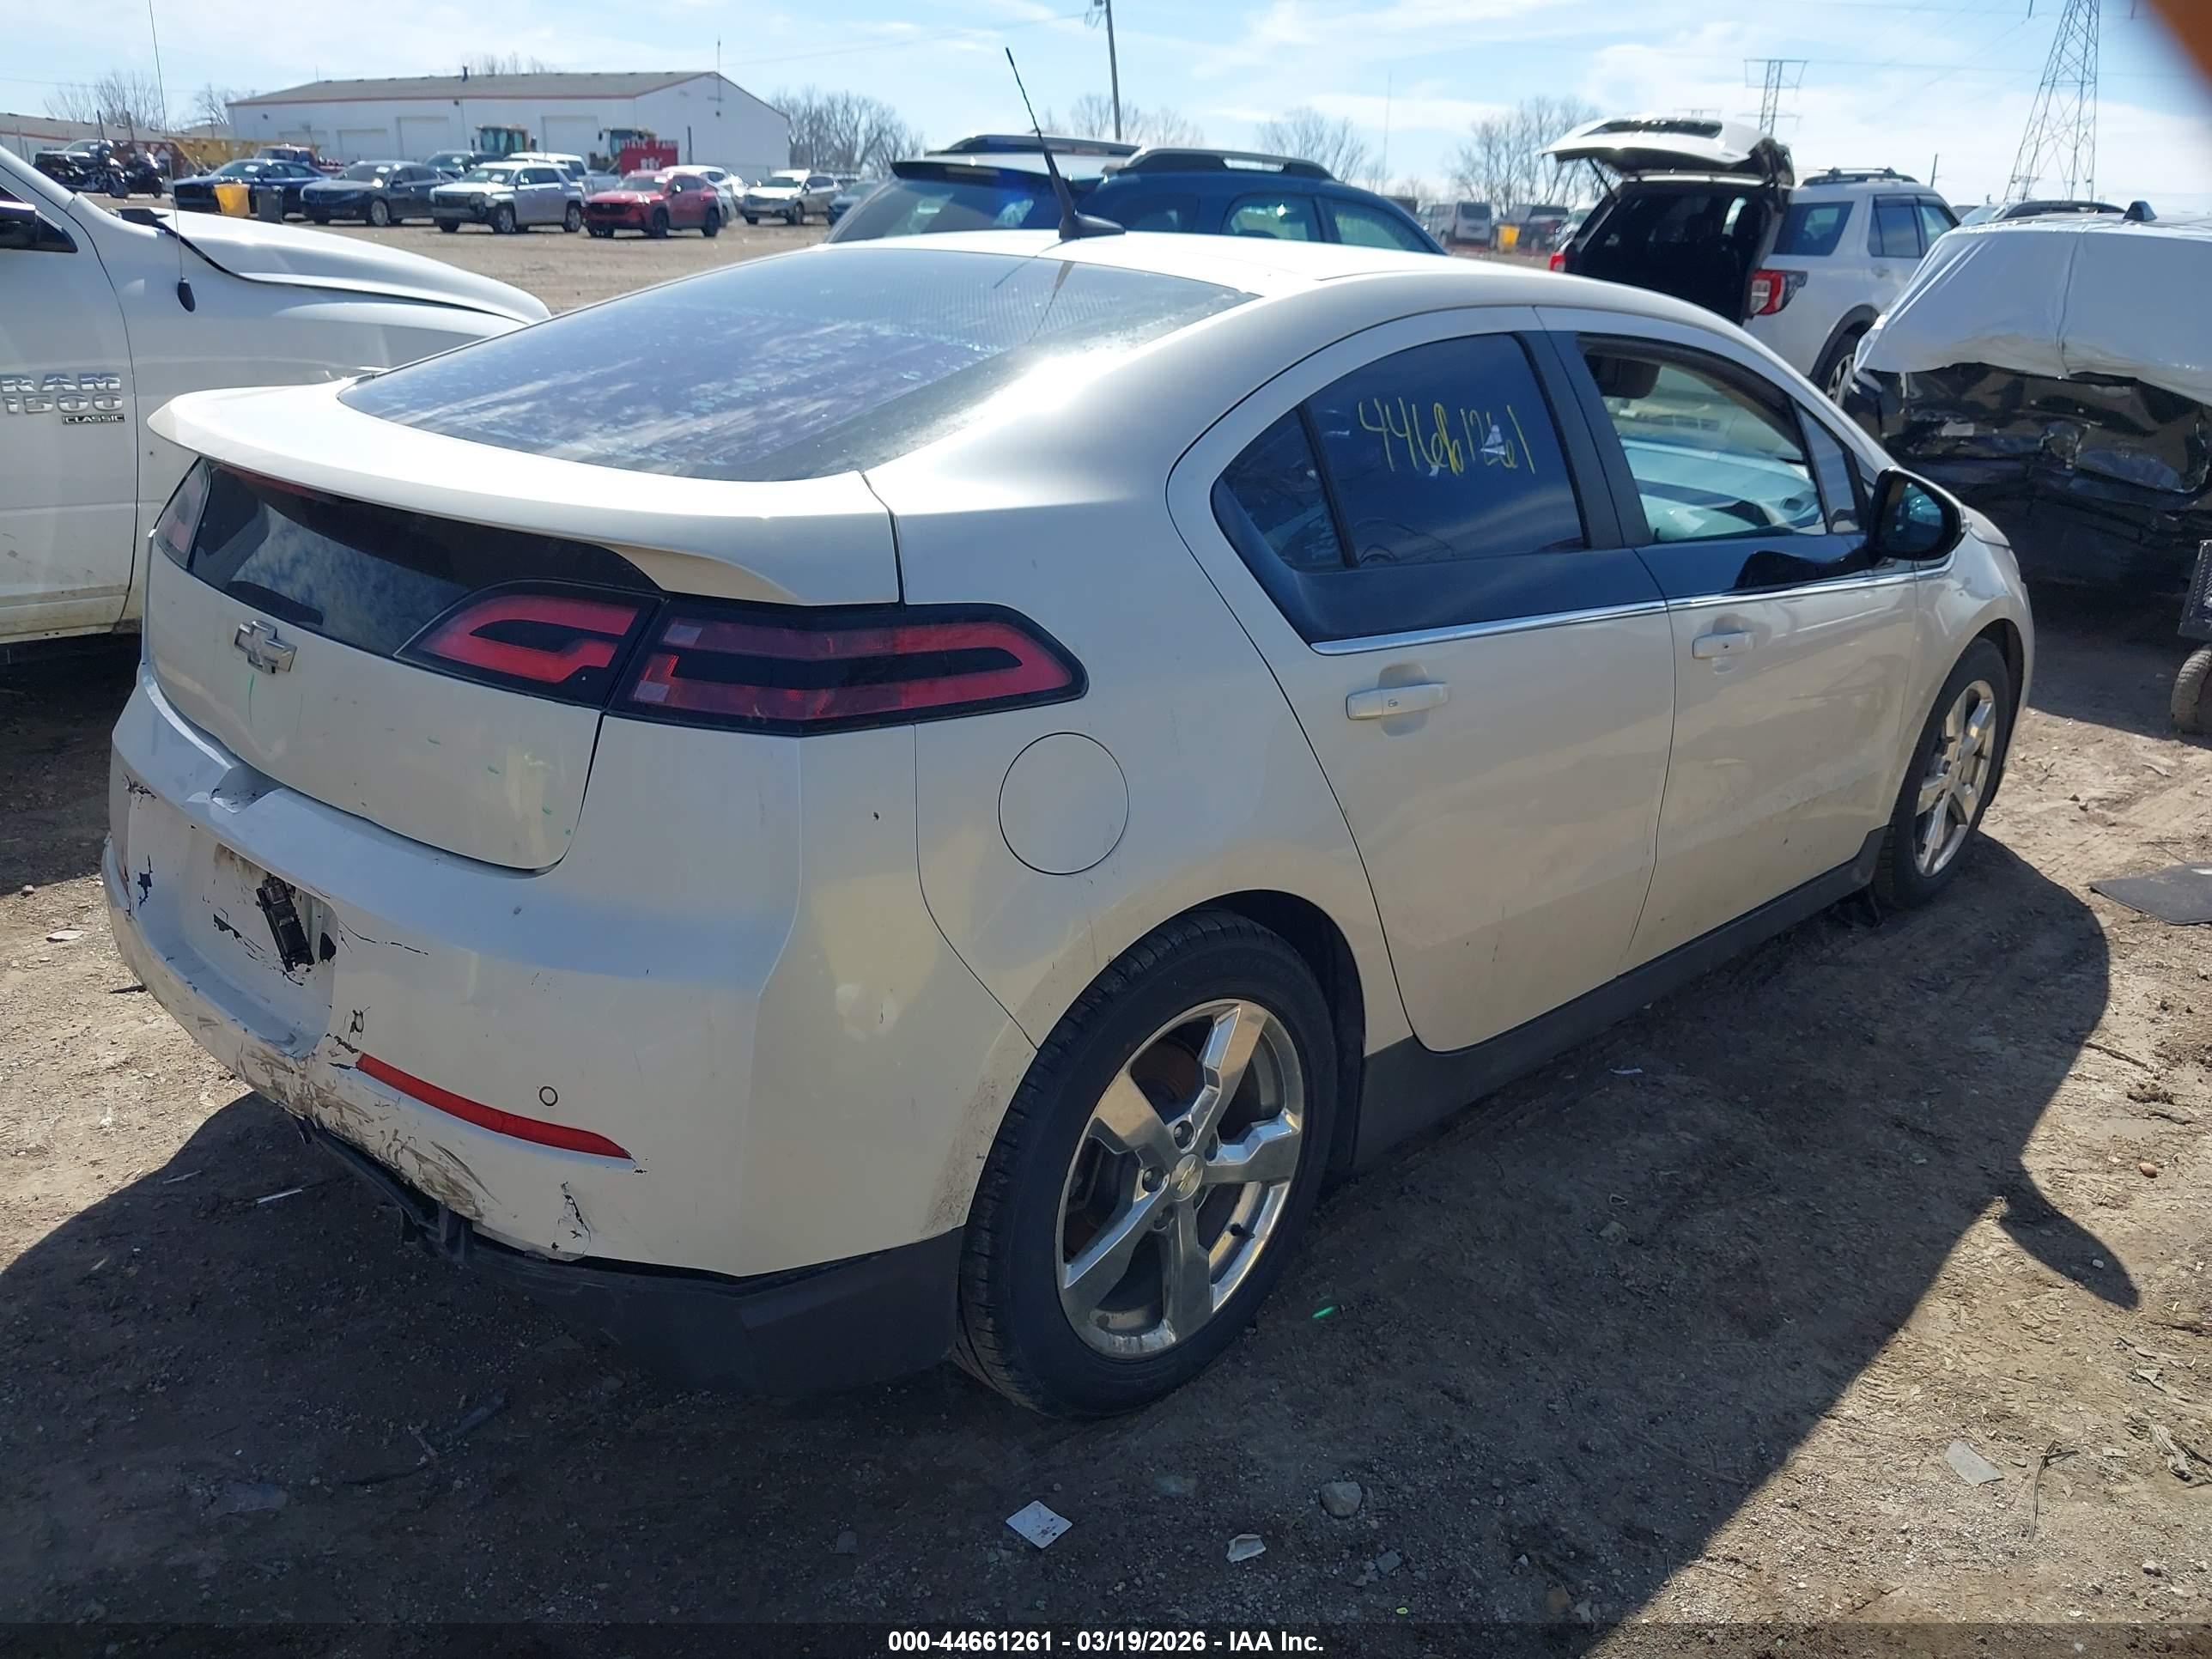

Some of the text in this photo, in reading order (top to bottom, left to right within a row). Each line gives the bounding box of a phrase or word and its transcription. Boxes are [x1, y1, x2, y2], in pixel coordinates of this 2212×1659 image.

[0, 373, 121, 392] RAM
[3, 393, 124, 414] 1500
[63, 414, 125, 424] CLASSIC
